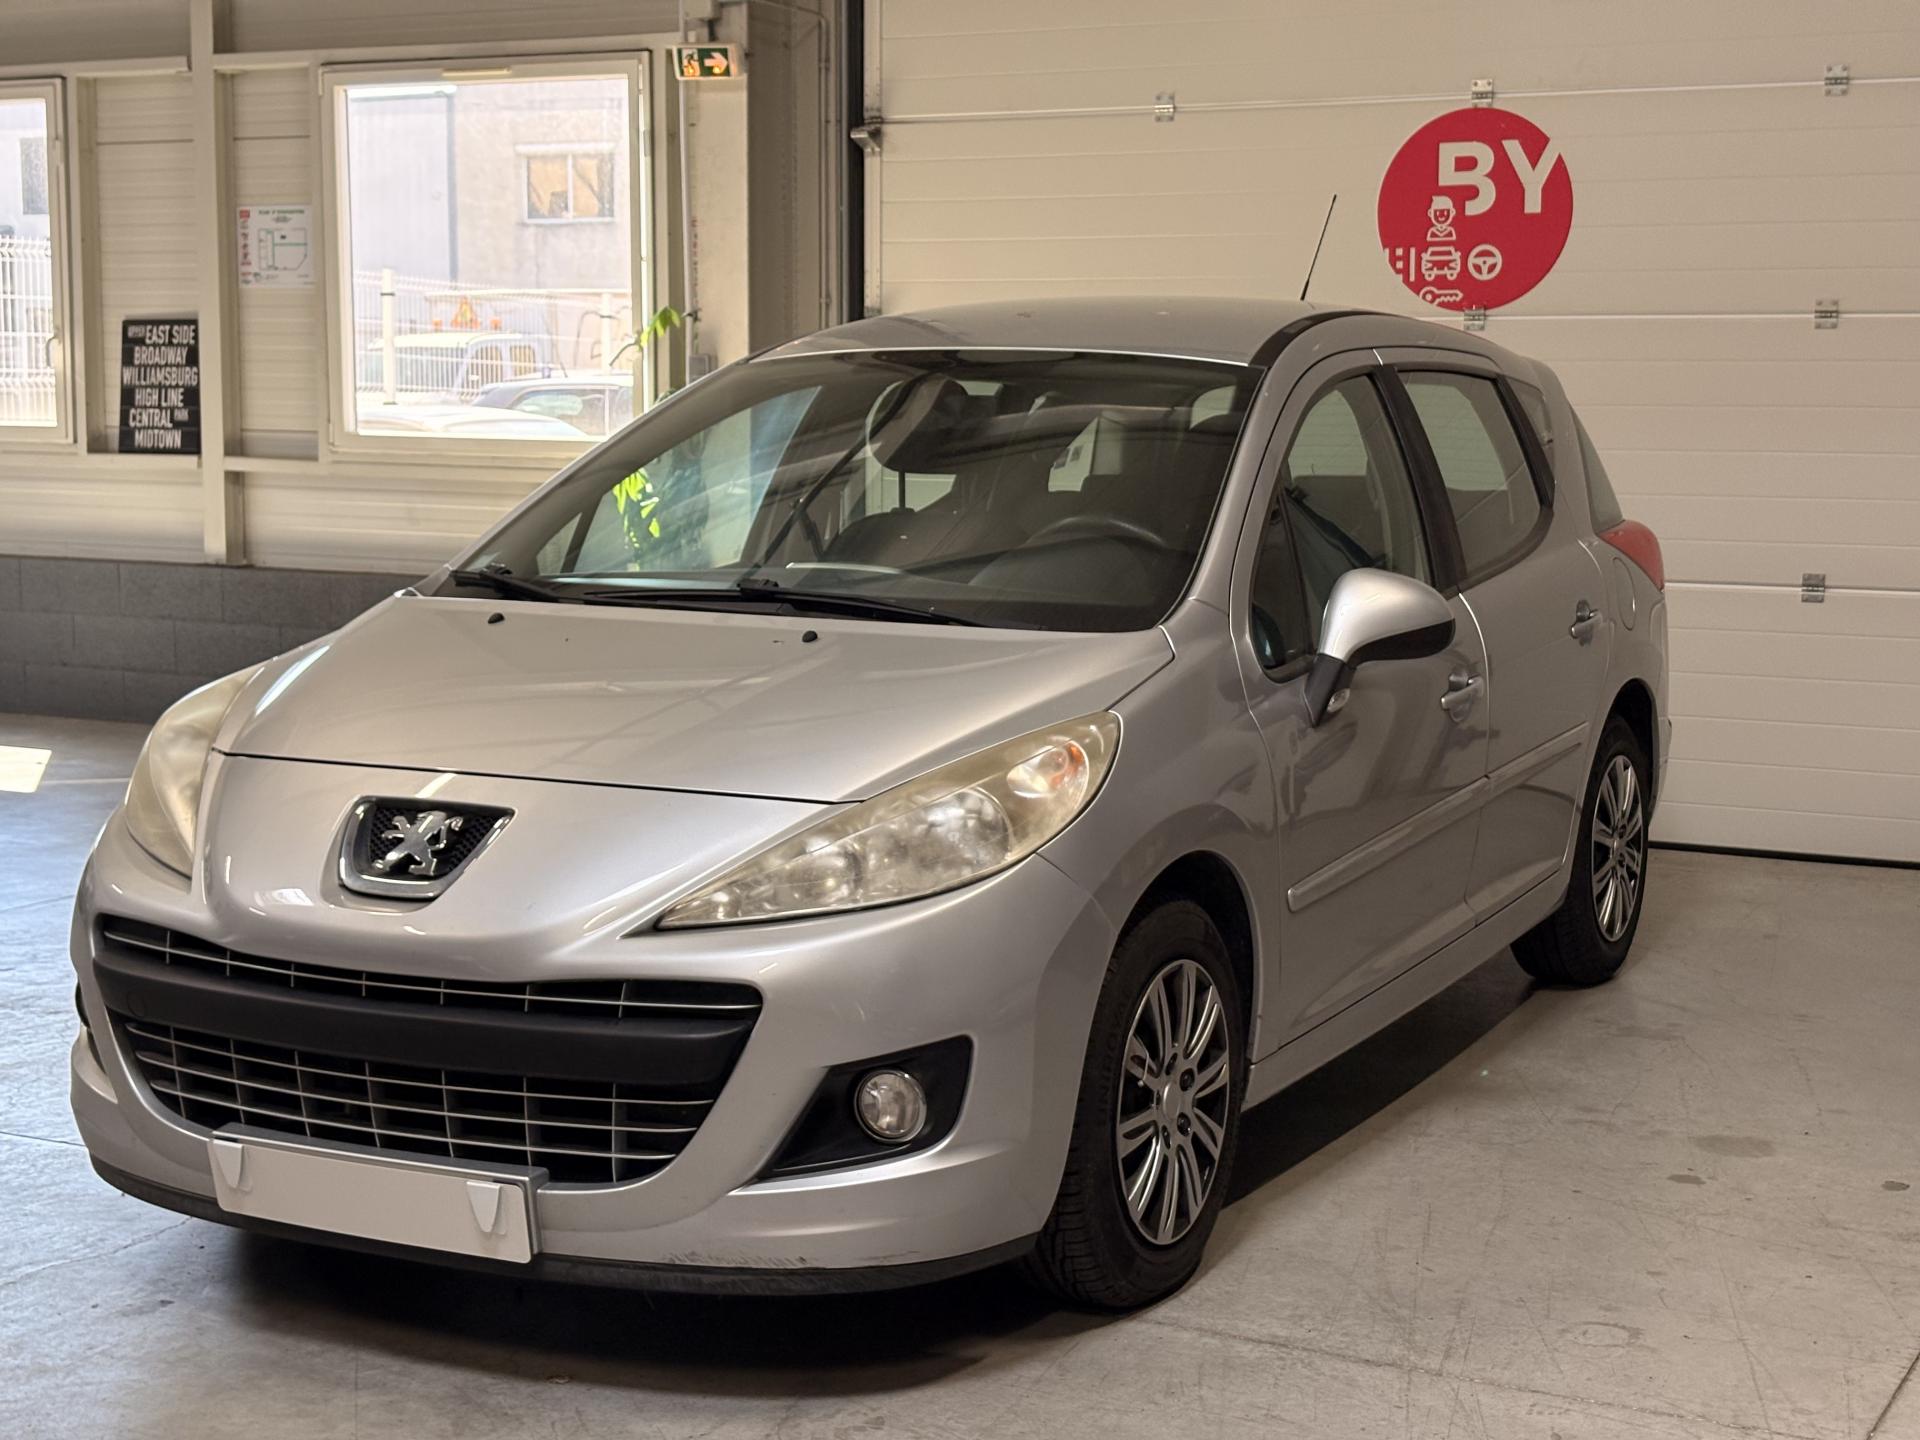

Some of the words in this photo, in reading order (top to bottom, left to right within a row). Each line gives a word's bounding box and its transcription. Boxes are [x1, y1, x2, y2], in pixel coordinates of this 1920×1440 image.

[1438, 139, 1560, 216] BY
[145, 325, 170, 344] EAST
[172, 325, 195, 344] SIDE
[134, 346, 188, 365] BROADWAY
[122, 366, 198, 386] WILLIAMSBURG
[135, 388, 158, 407] HIGH
[161, 388, 184, 407] LINE
[129, 408, 173, 427] CENTRAL
[134, 429, 181, 448] MIDTOWN
